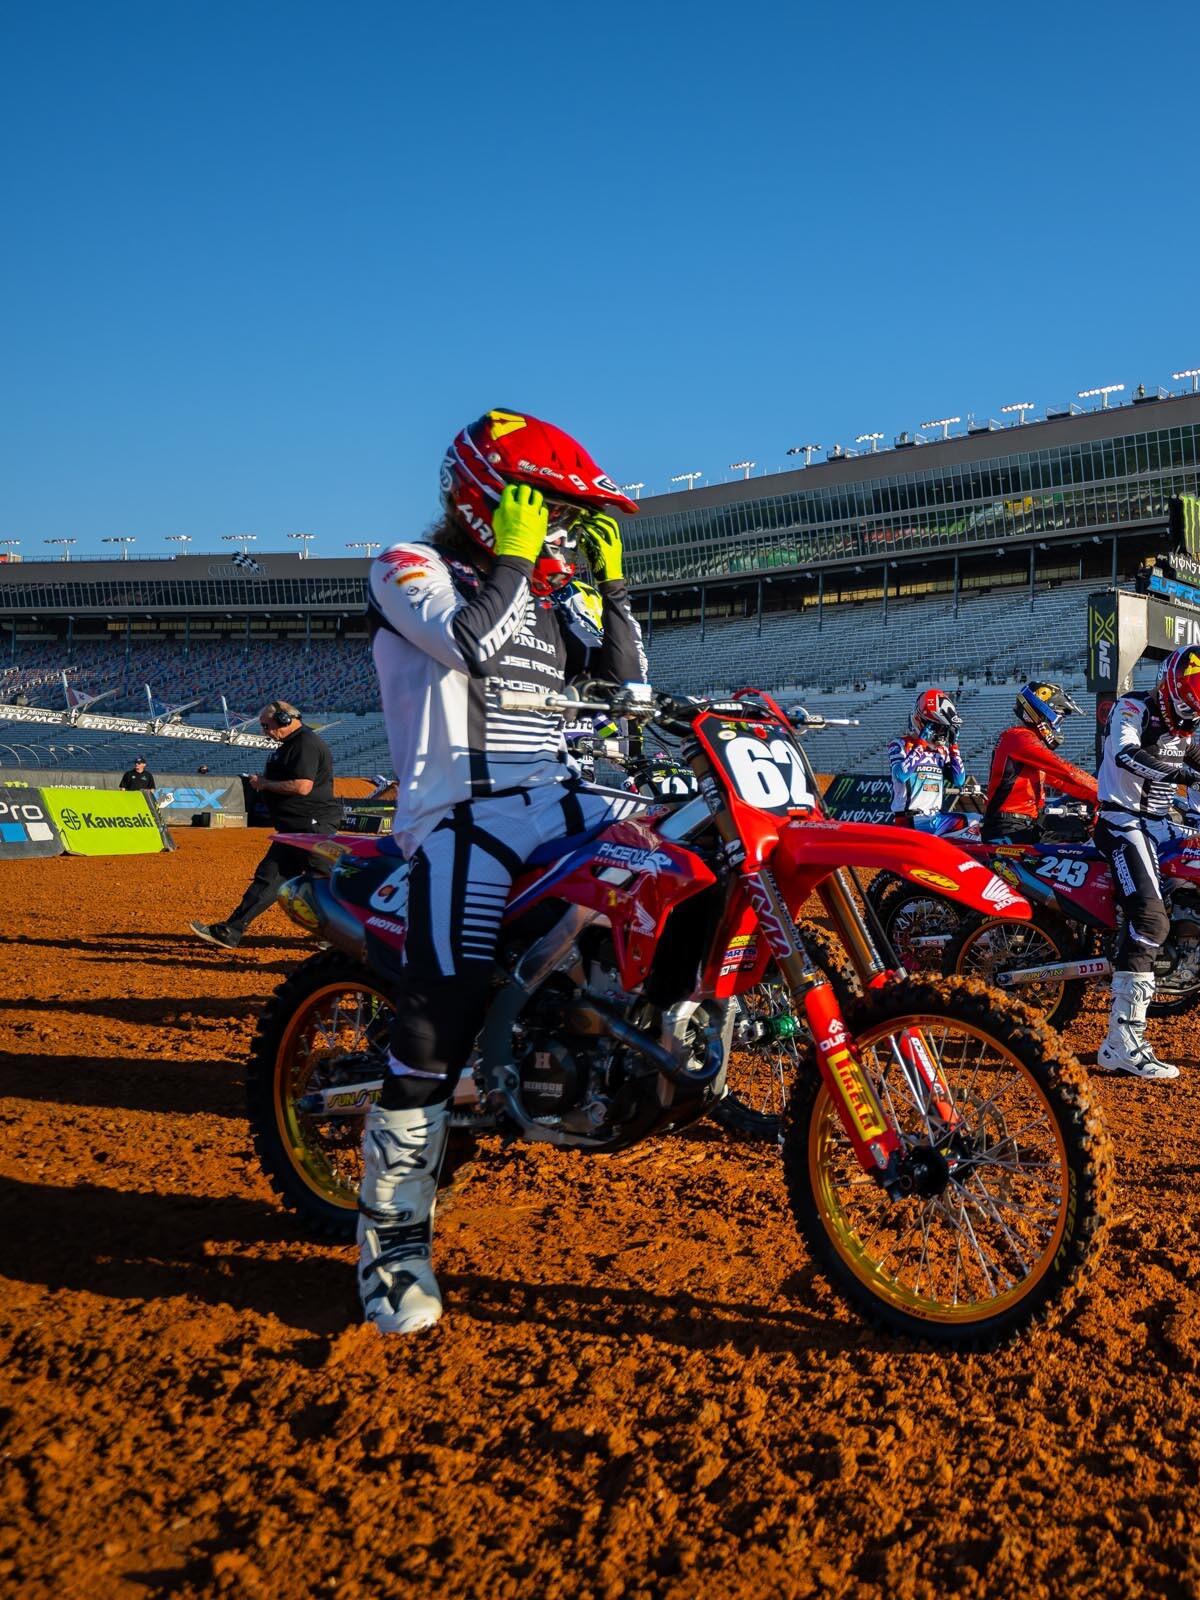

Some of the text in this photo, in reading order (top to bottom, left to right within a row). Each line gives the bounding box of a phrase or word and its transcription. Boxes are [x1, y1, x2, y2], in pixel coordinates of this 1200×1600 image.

[725, 737, 816, 809] 62
[916, 766, 943, 774] MOTO
[81, 812, 156, 830] Kawasaki
[598, 843, 649, 865] PHOENIX
[1035, 855, 1090, 888] 243
[366, 916, 403, 935] MOTUL
[1078, 963, 1104, 975] DID
